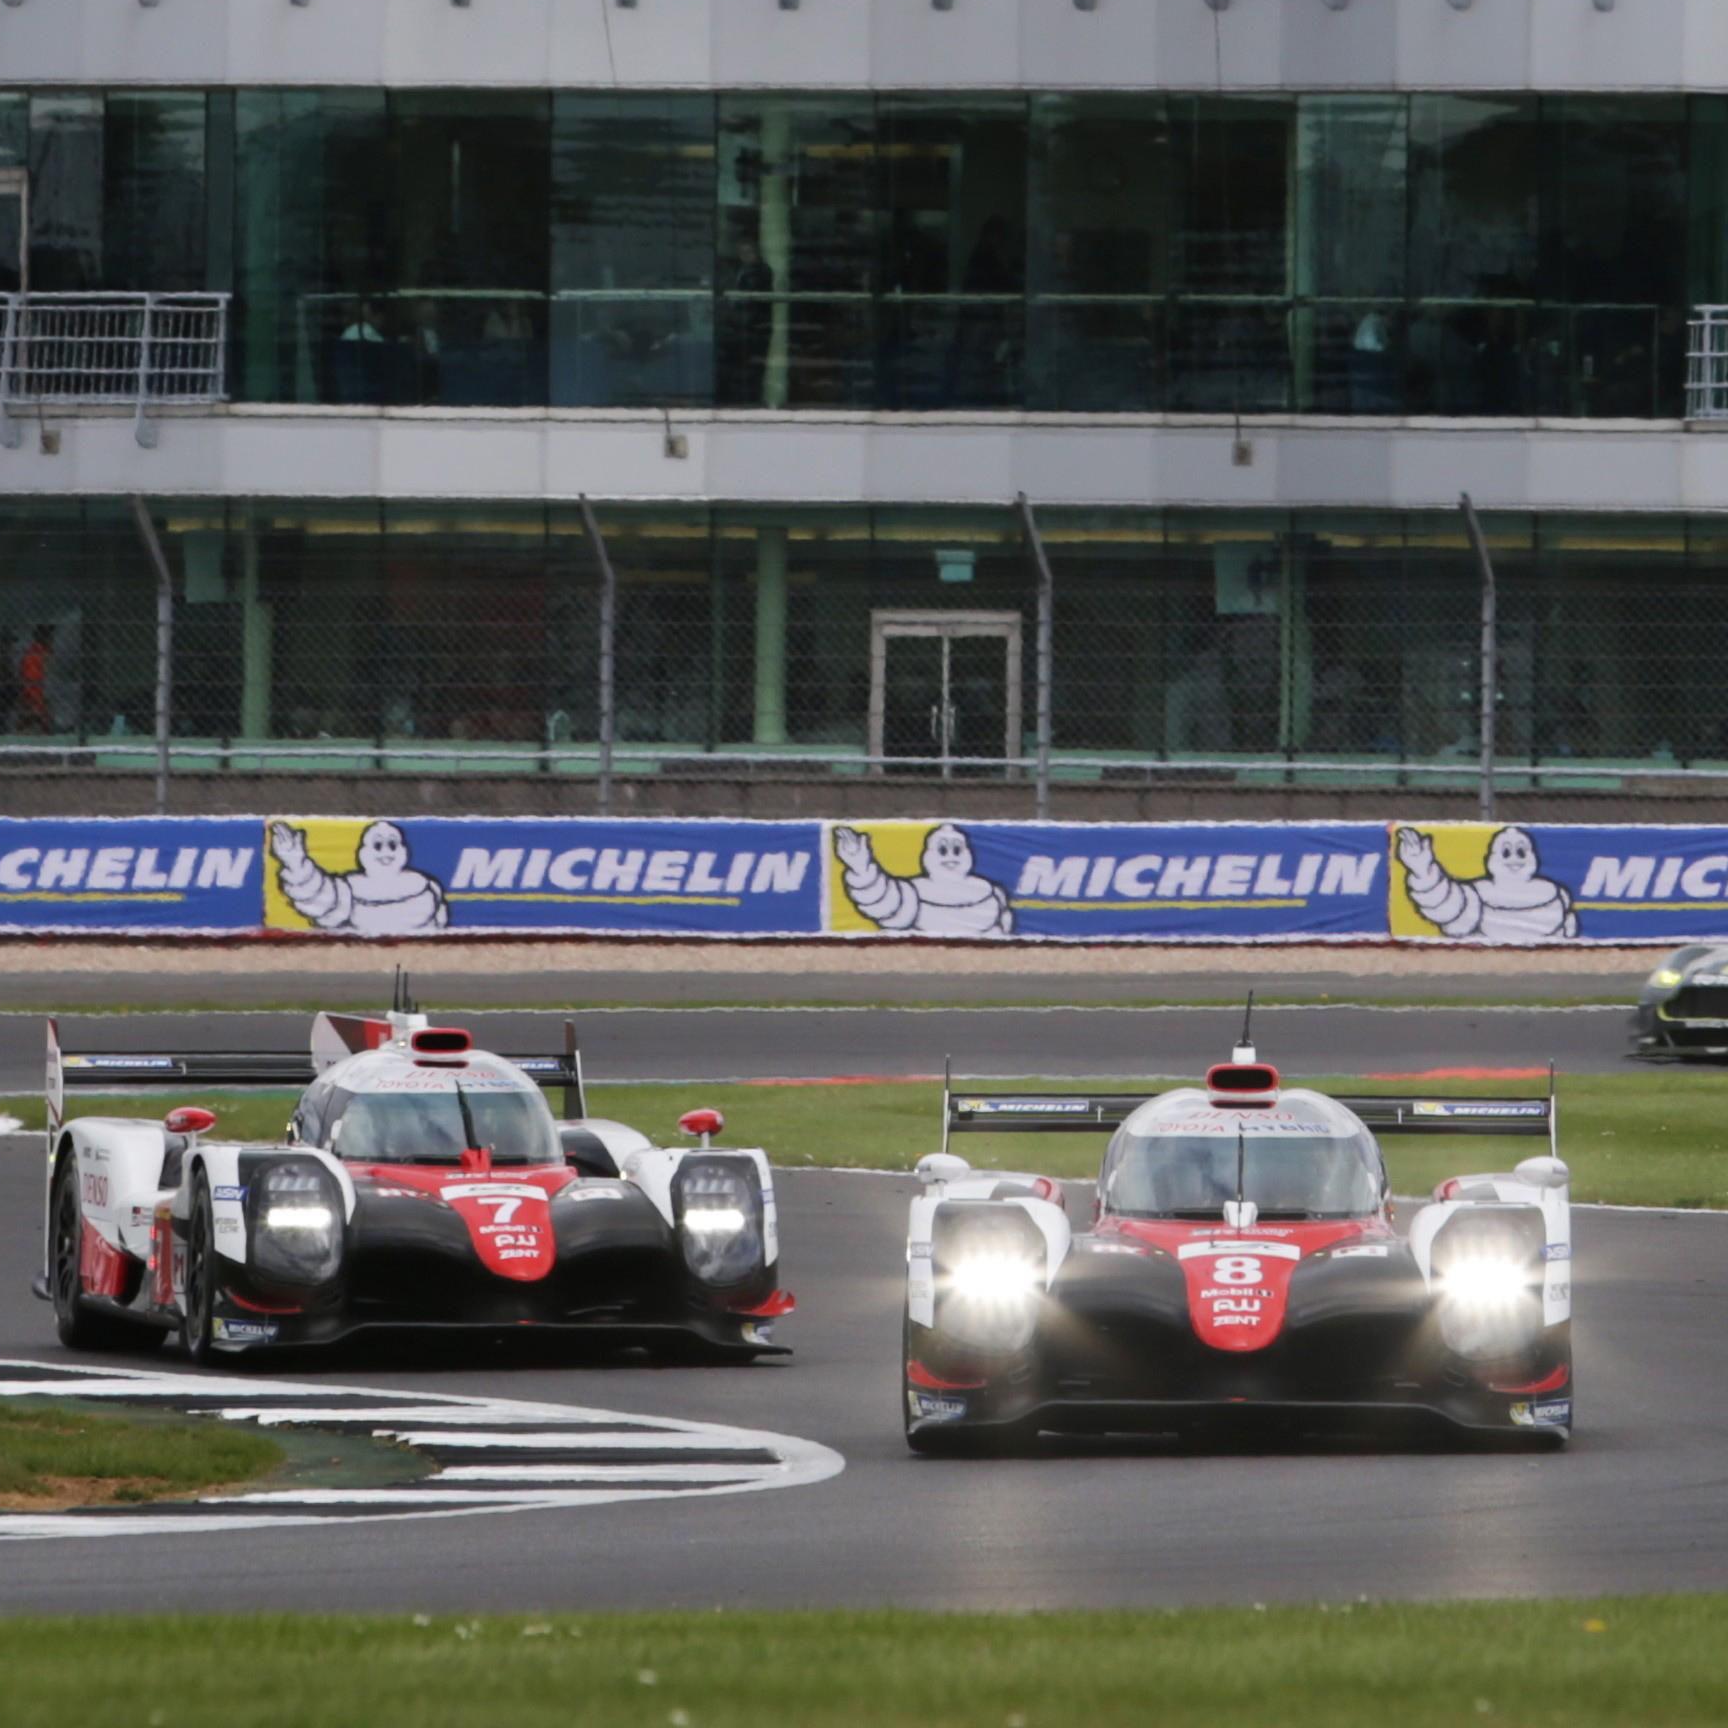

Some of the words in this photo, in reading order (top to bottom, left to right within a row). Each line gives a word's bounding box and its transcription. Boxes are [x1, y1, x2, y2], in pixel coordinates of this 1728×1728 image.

[450, 847, 811, 893] MICHELIN
[1016, 852, 1381, 897] MICHELIN
[376, 1079, 444, 1089] TOYOTA
[998, 1104, 1086, 1112] MICHELIN
[1453, 1106, 1541, 1115] MICHELIN
[477, 1197, 522, 1223] 7
[1213, 1256, 1263, 1285] 8
[1200, 1288, 1253, 1298] Mobil
[1213, 1315, 1261, 1327] ZENT
